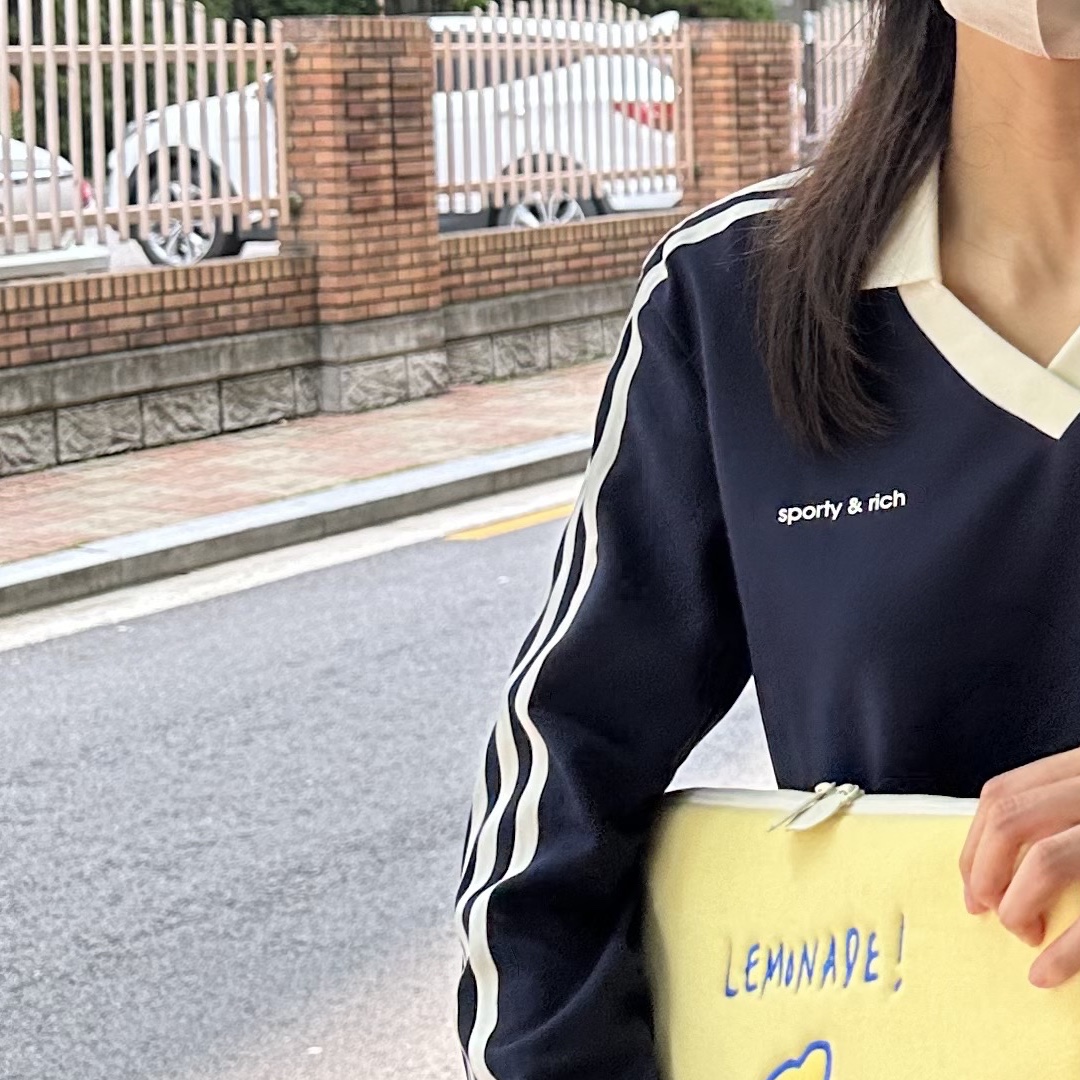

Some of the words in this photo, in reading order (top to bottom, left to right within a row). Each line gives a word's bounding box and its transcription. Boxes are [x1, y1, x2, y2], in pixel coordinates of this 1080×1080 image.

[777, 499, 843, 526] sporty
[847, 497, 863, 515] &
[868, 489, 906, 512] rich
